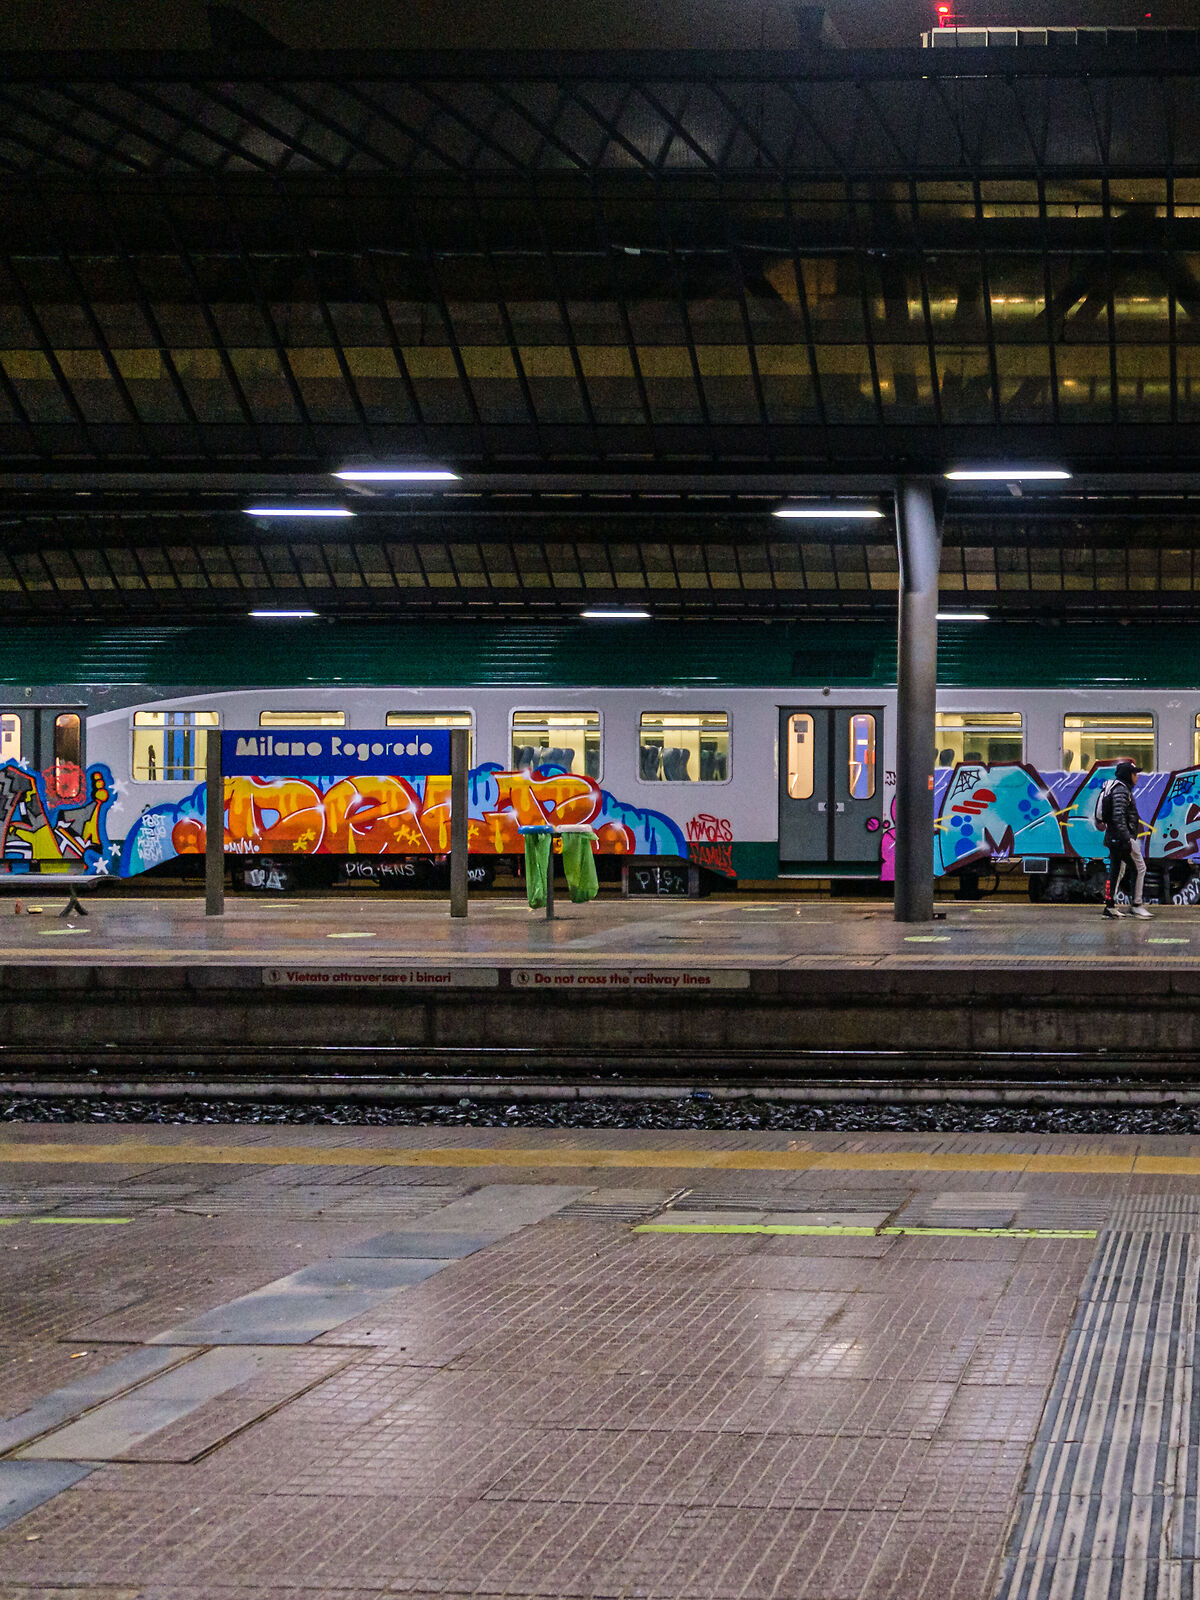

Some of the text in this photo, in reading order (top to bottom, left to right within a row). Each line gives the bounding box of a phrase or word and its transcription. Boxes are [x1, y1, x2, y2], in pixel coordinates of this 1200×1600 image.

[236, 735, 433, 761] Milano Rogoredo
[286, 971, 451, 983] Vietato attraversare i binari
[534, 973, 711, 987] Do not cross the railway lines
